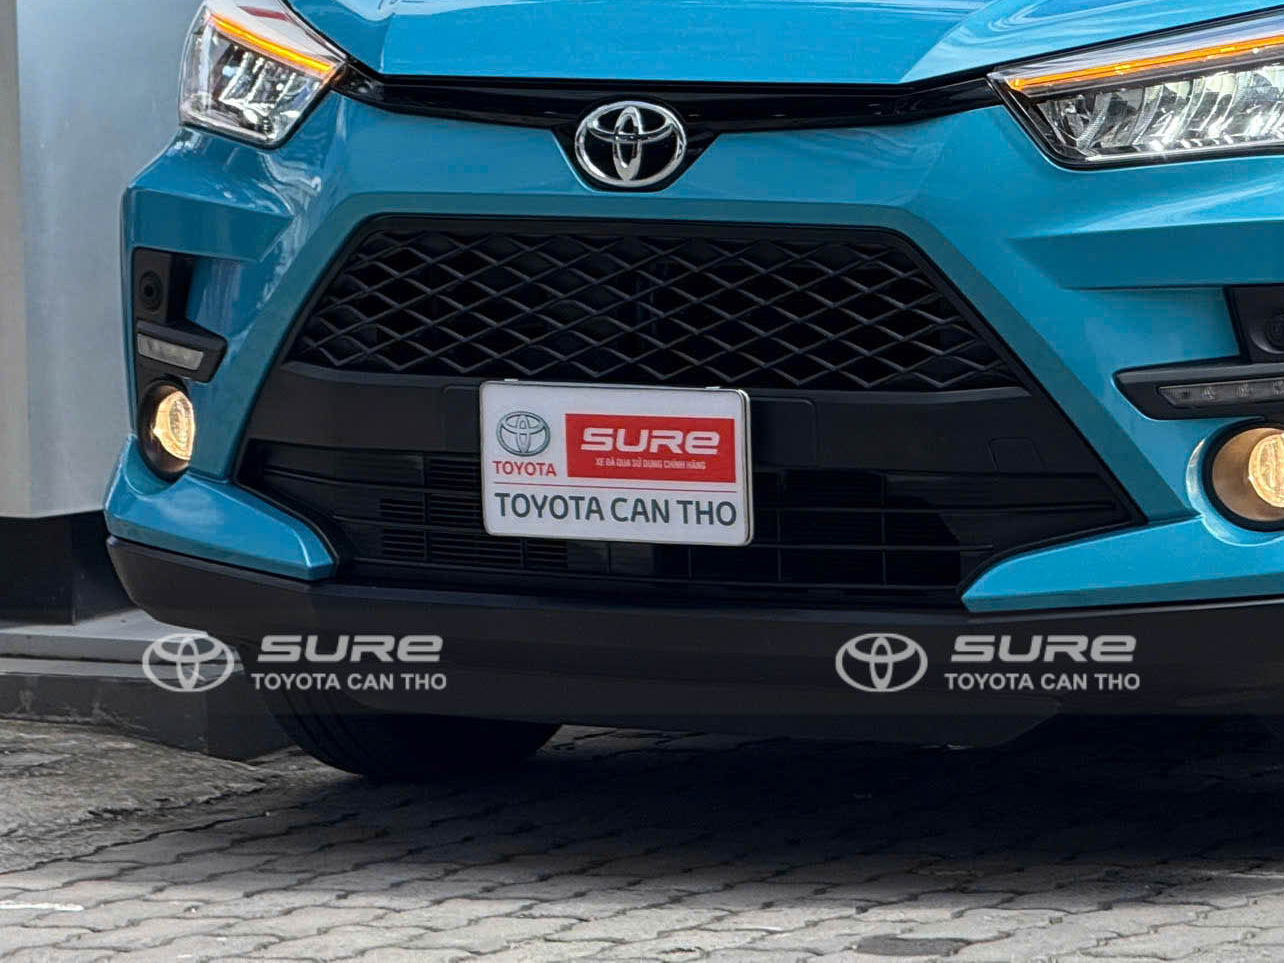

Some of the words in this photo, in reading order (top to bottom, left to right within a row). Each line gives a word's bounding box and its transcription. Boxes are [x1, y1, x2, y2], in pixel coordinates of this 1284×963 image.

[492, 460, 557, 477] TOYOTA
[494, 492, 604, 522] TOYOTA
[610, 497, 670, 524] CAN
[676, 499, 737, 527] THO
